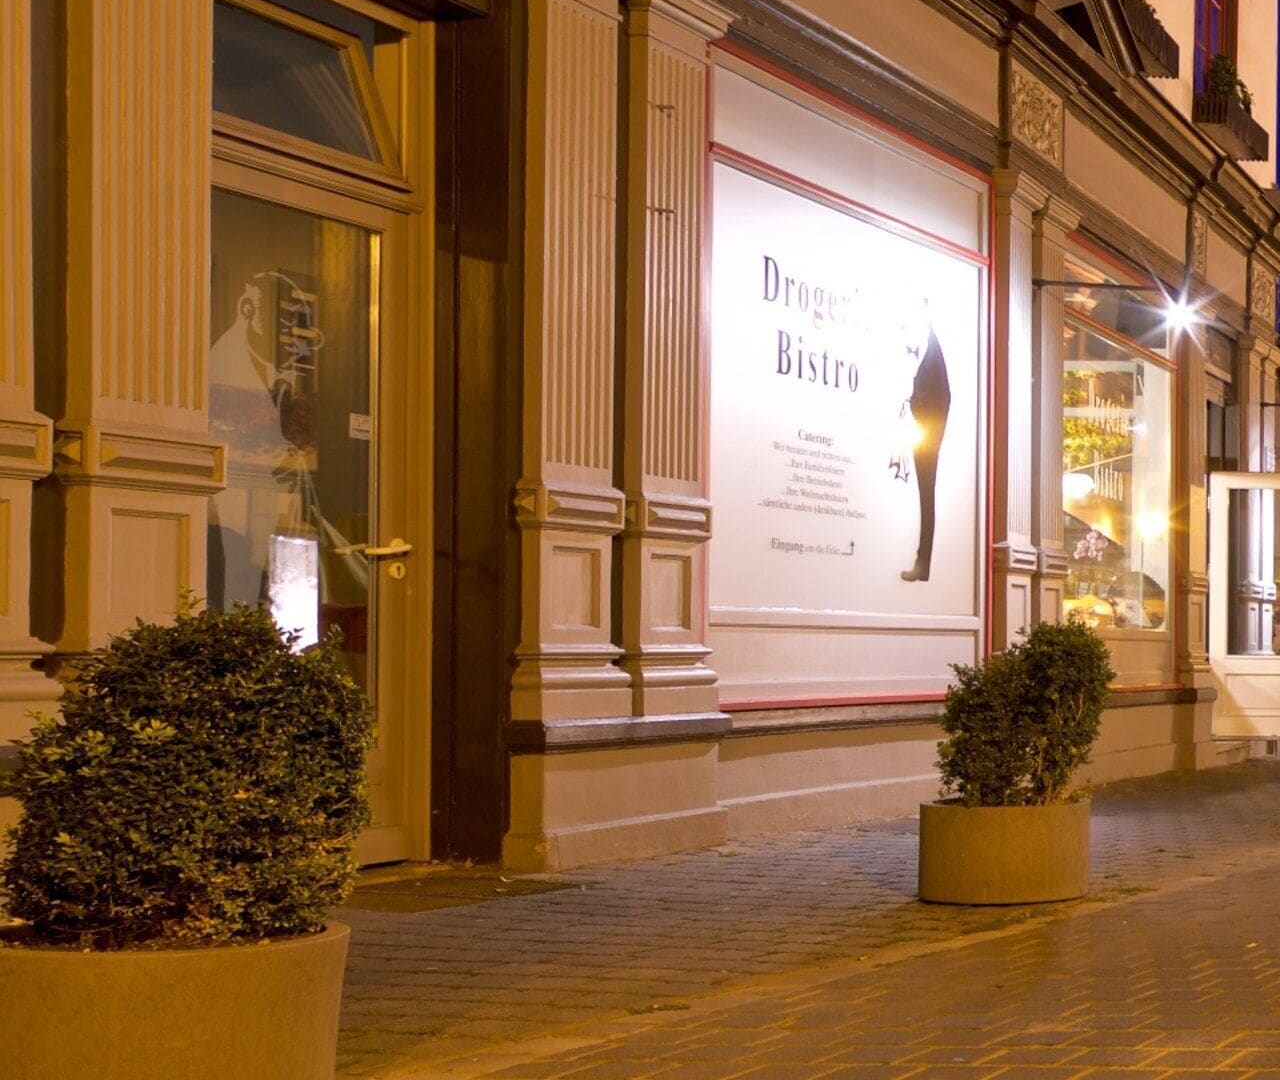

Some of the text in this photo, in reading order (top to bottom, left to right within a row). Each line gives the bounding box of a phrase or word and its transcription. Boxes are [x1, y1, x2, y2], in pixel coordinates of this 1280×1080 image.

[763, 255, 869, 331] Droge
[776, 330, 859, 393] Bistro
[798, 428, 834, 446] Catering:
[1093, 449, 1123, 502] Bistro
[771, 537, 804, 554] Eingang
